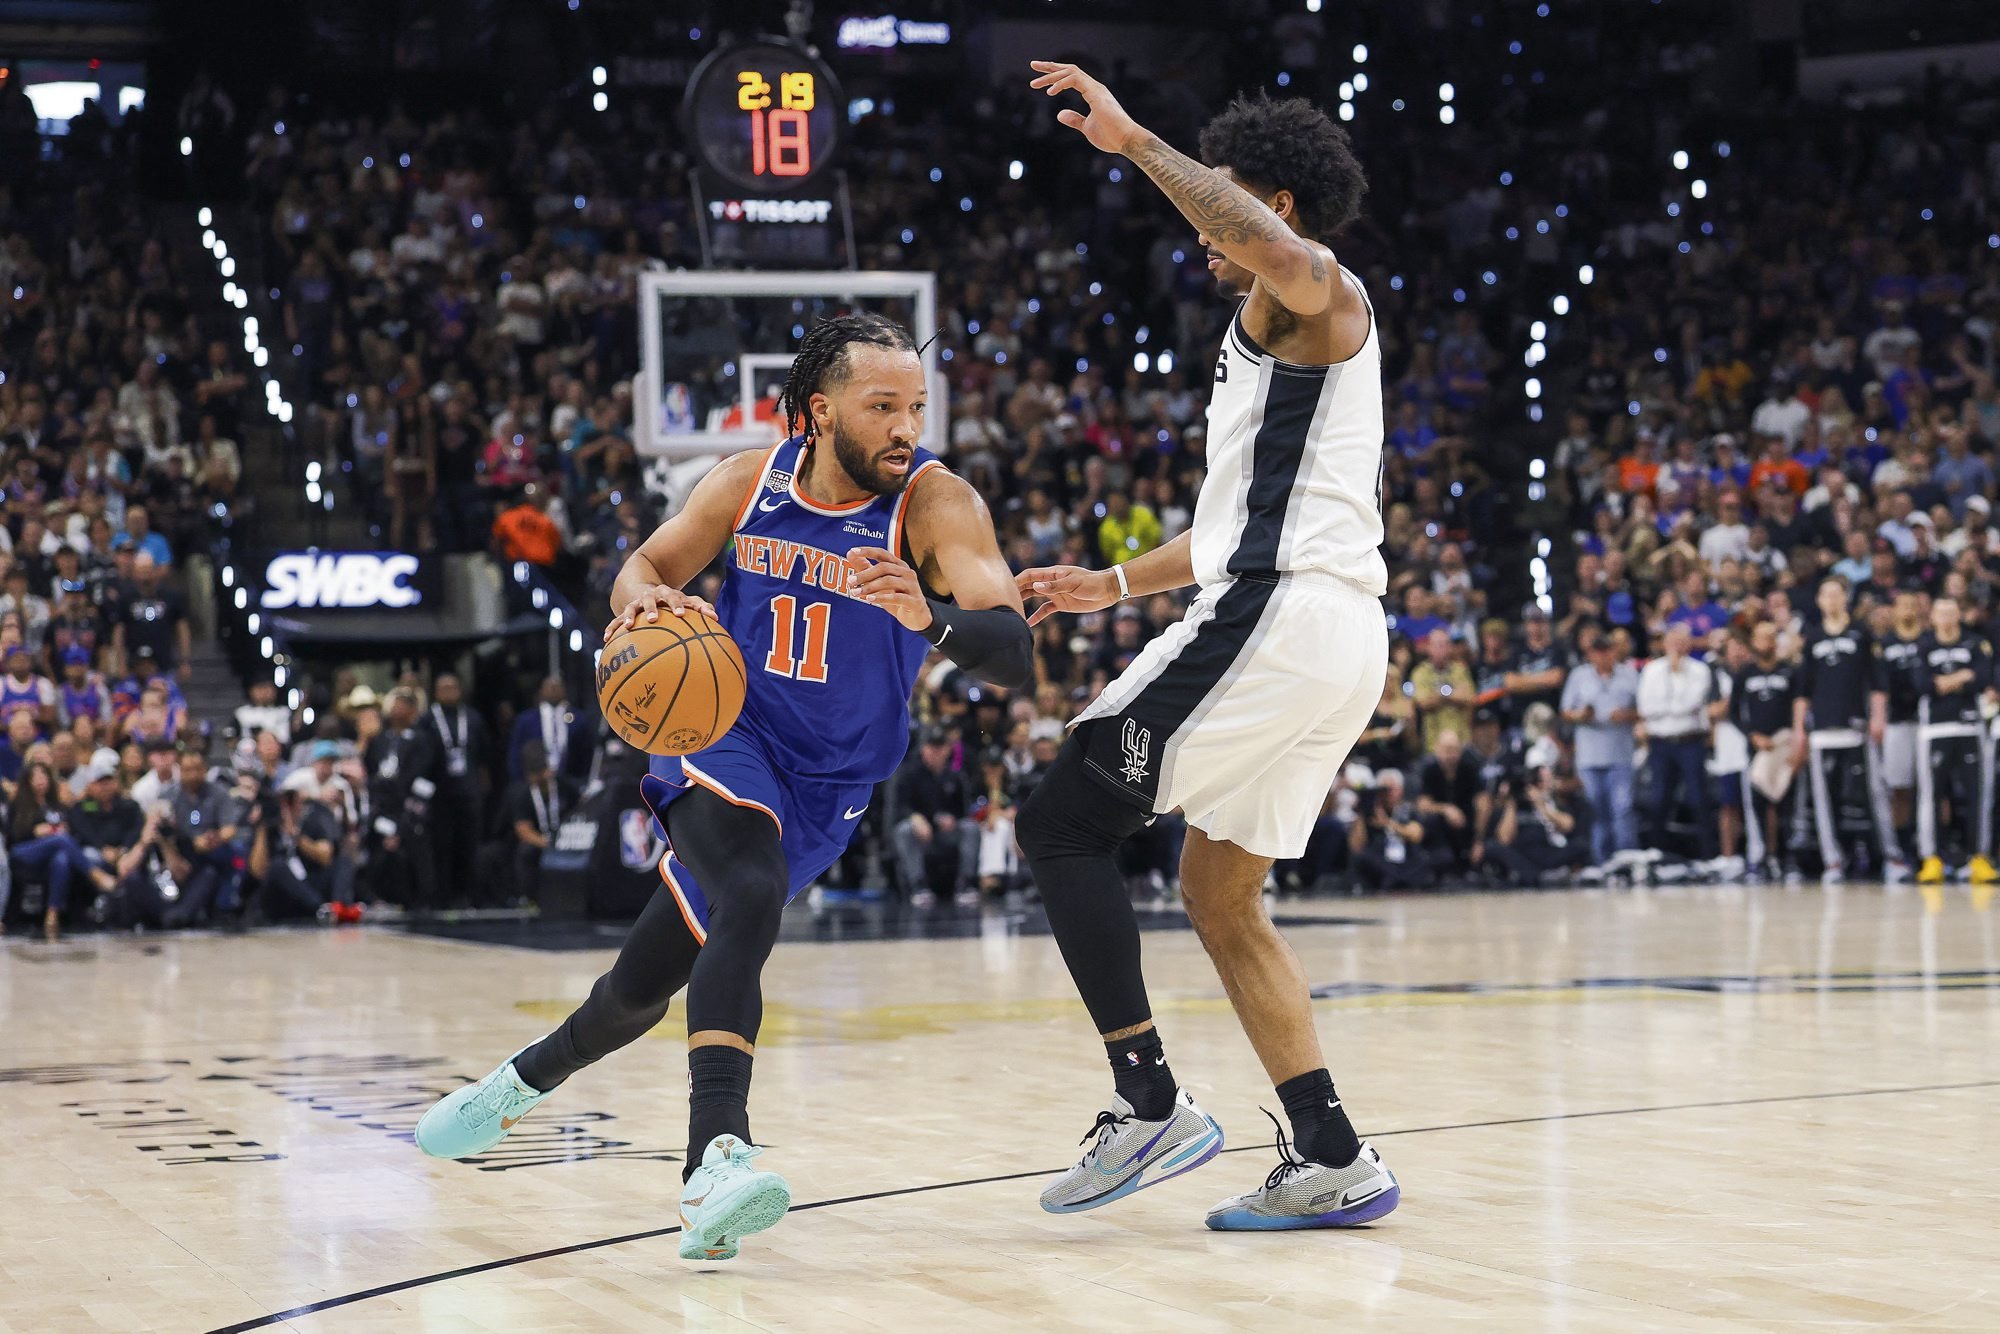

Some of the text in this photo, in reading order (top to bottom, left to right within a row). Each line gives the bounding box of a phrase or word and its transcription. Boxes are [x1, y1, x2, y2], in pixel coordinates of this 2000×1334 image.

[738, 71, 814, 111] 2:19
[751, 108, 810, 176] 18
[772, 472, 789, 481] USA
[843, 525, 885, 539] abu dhabi
[260, 554, 420, 609] SWBC
[733, 532, 864, 600] NEW YOR
[764, 594, 831, 683] 11
